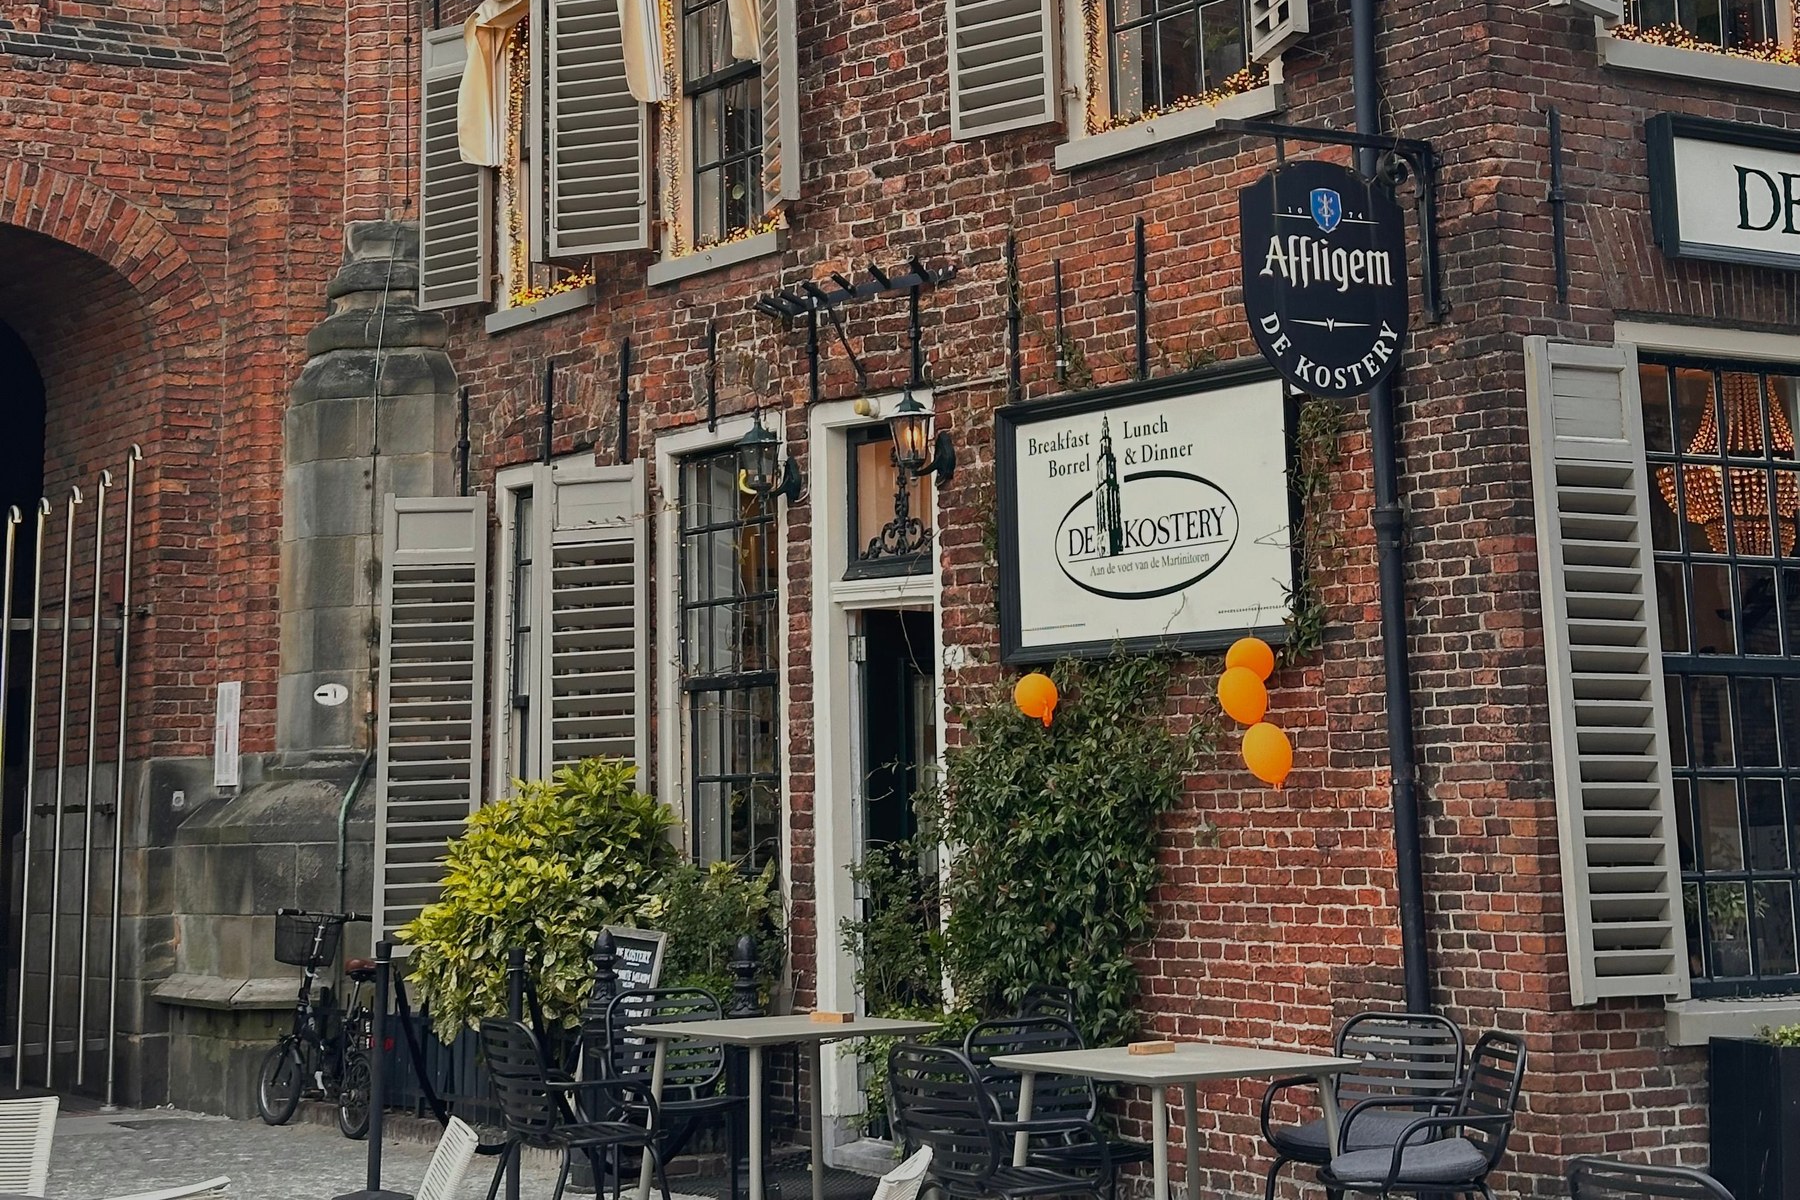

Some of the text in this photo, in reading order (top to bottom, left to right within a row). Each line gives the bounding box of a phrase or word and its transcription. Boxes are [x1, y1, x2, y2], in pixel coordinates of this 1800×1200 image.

[1733, 164, 1800, 235] DE
[1259, 234, 1393, 292] Affligem
[1260, 311, 1399, 390] DE KOSTERY
[1028, 414, 1169, 456] Breakfast Lunch
[1048, 443, 1194, 478] Borrel & Dinner
[1068, 505, 1226, 557] DE KOSTERY
[1090, 552, 1210, 577] Aan de voet van de Martinitoren
